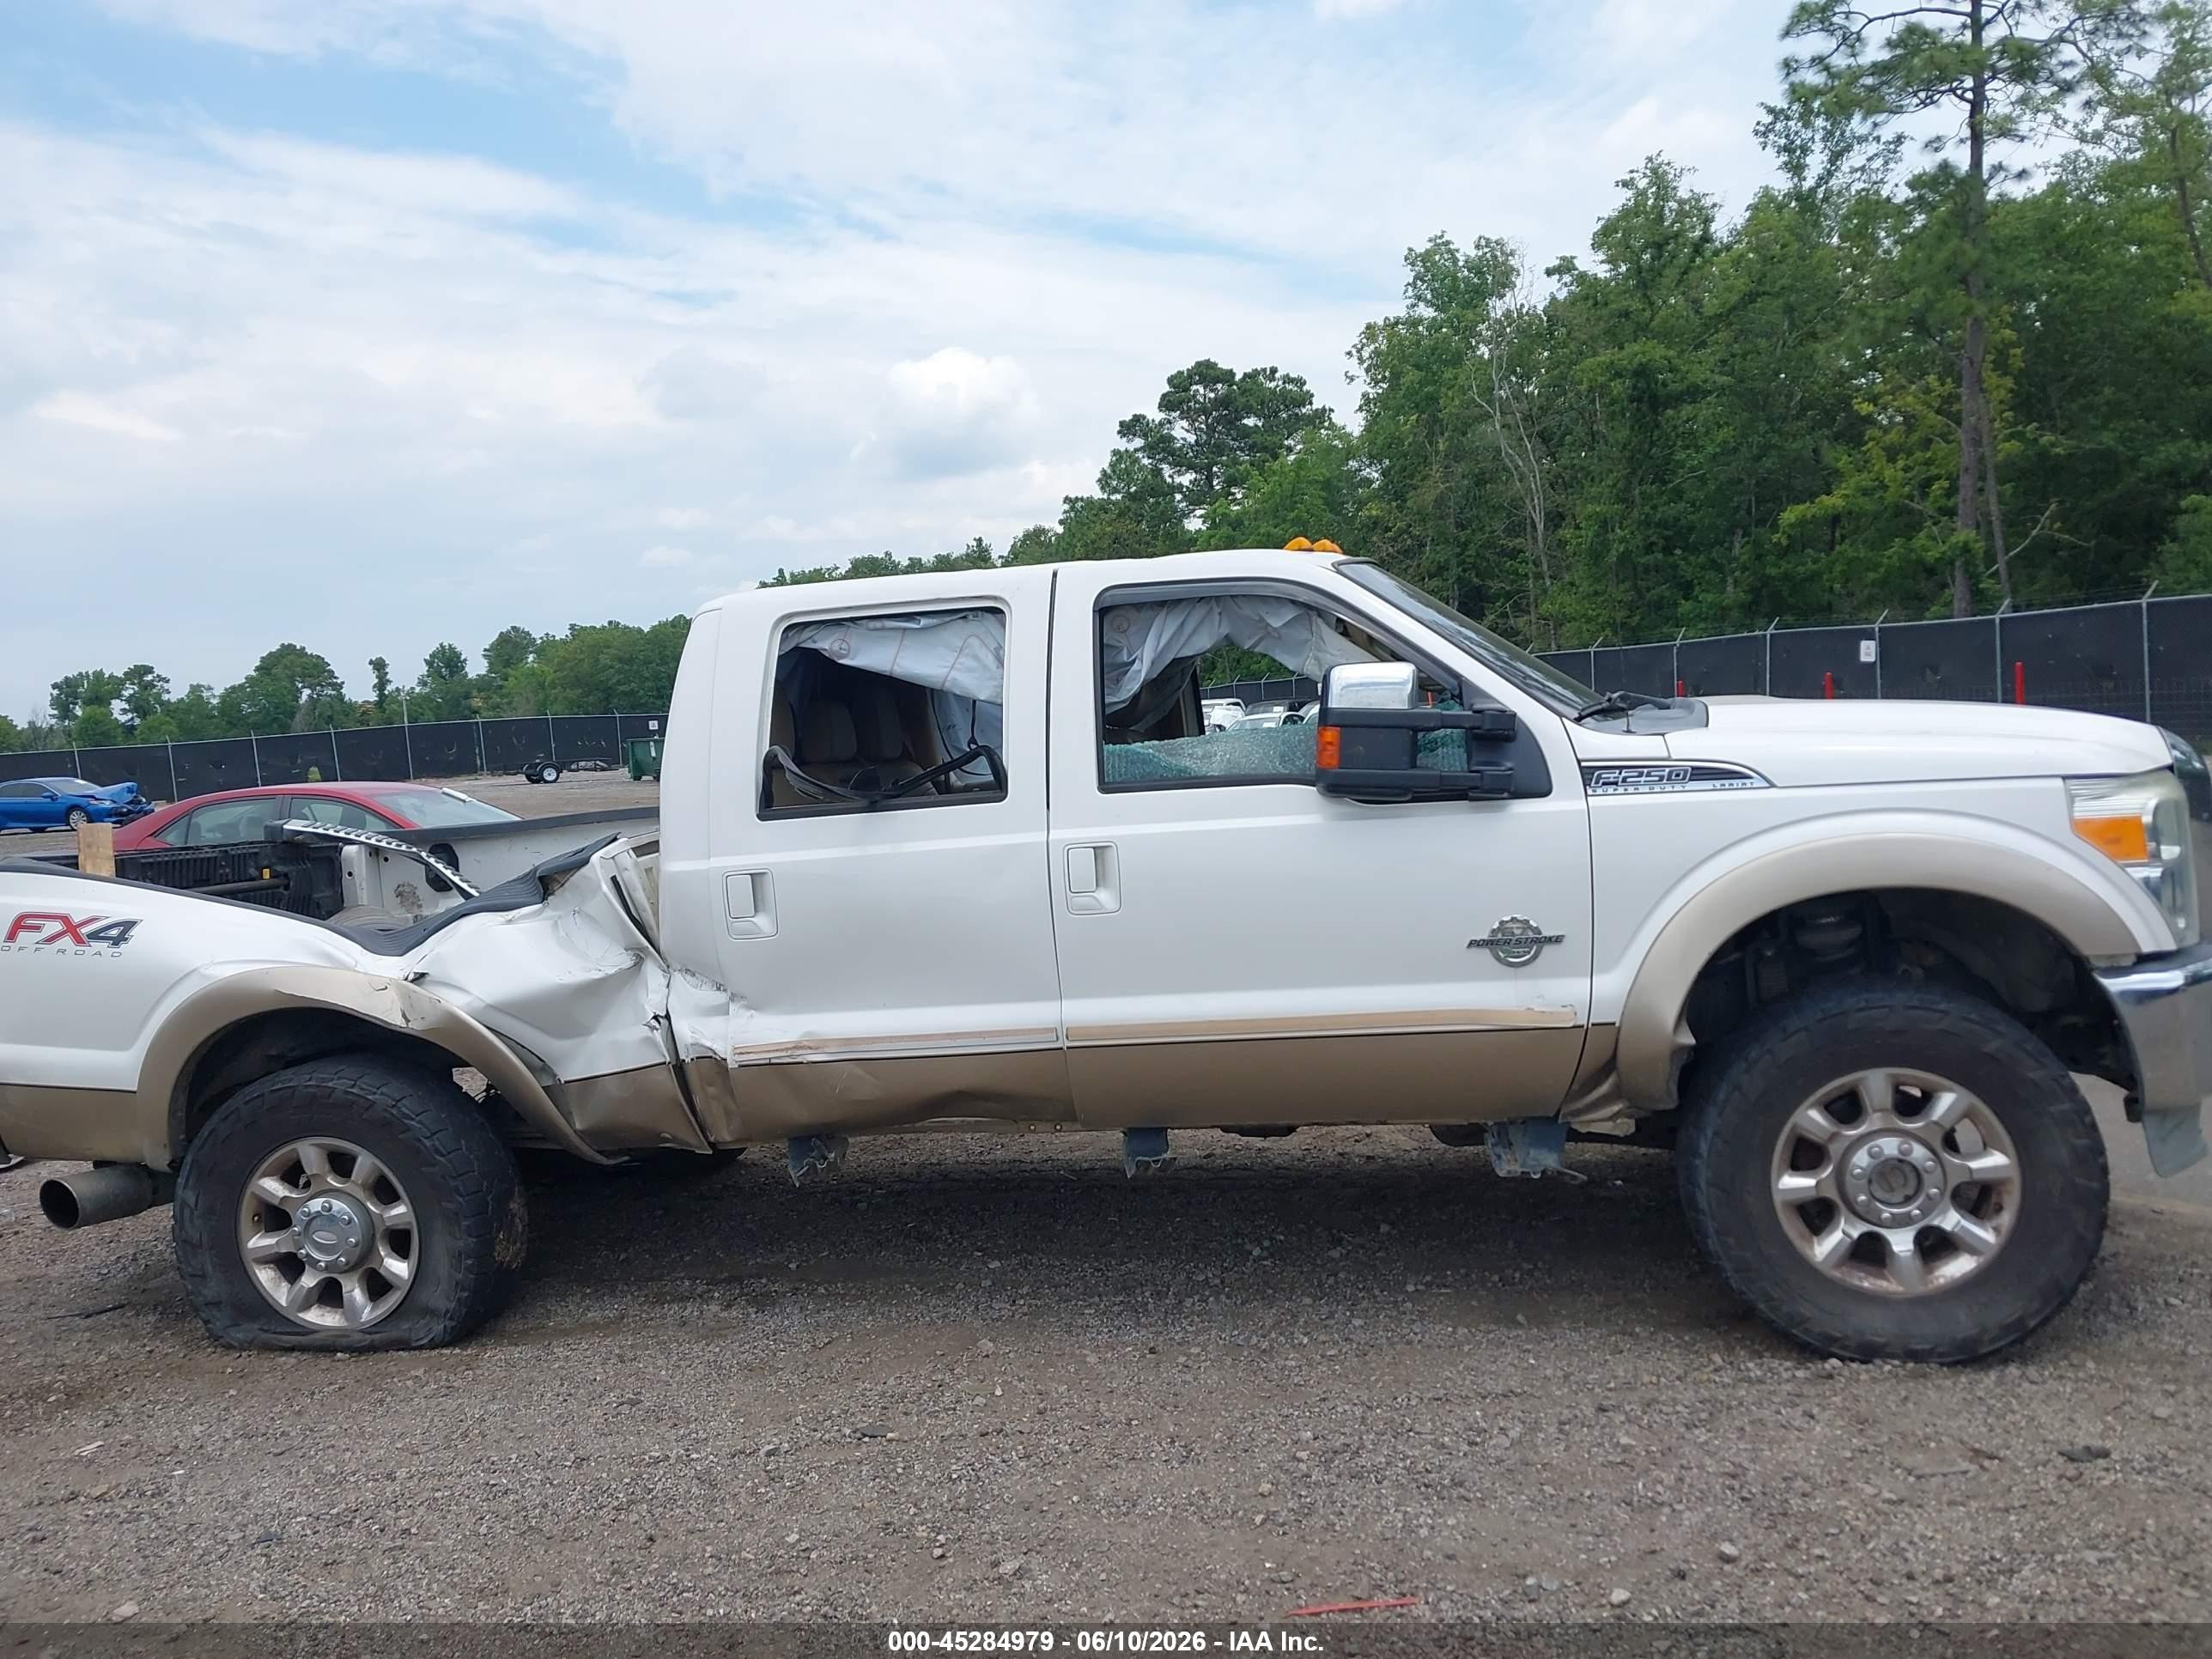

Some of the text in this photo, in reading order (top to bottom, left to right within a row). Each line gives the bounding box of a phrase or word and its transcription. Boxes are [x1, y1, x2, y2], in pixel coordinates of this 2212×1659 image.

[1591, 767, 1692, 787] F-250
[3, 912, 143, 948] FX4
[1467, 934, 1565, 949] POWER STROKE
[1, 945, 123, 958] OFF ROAD
